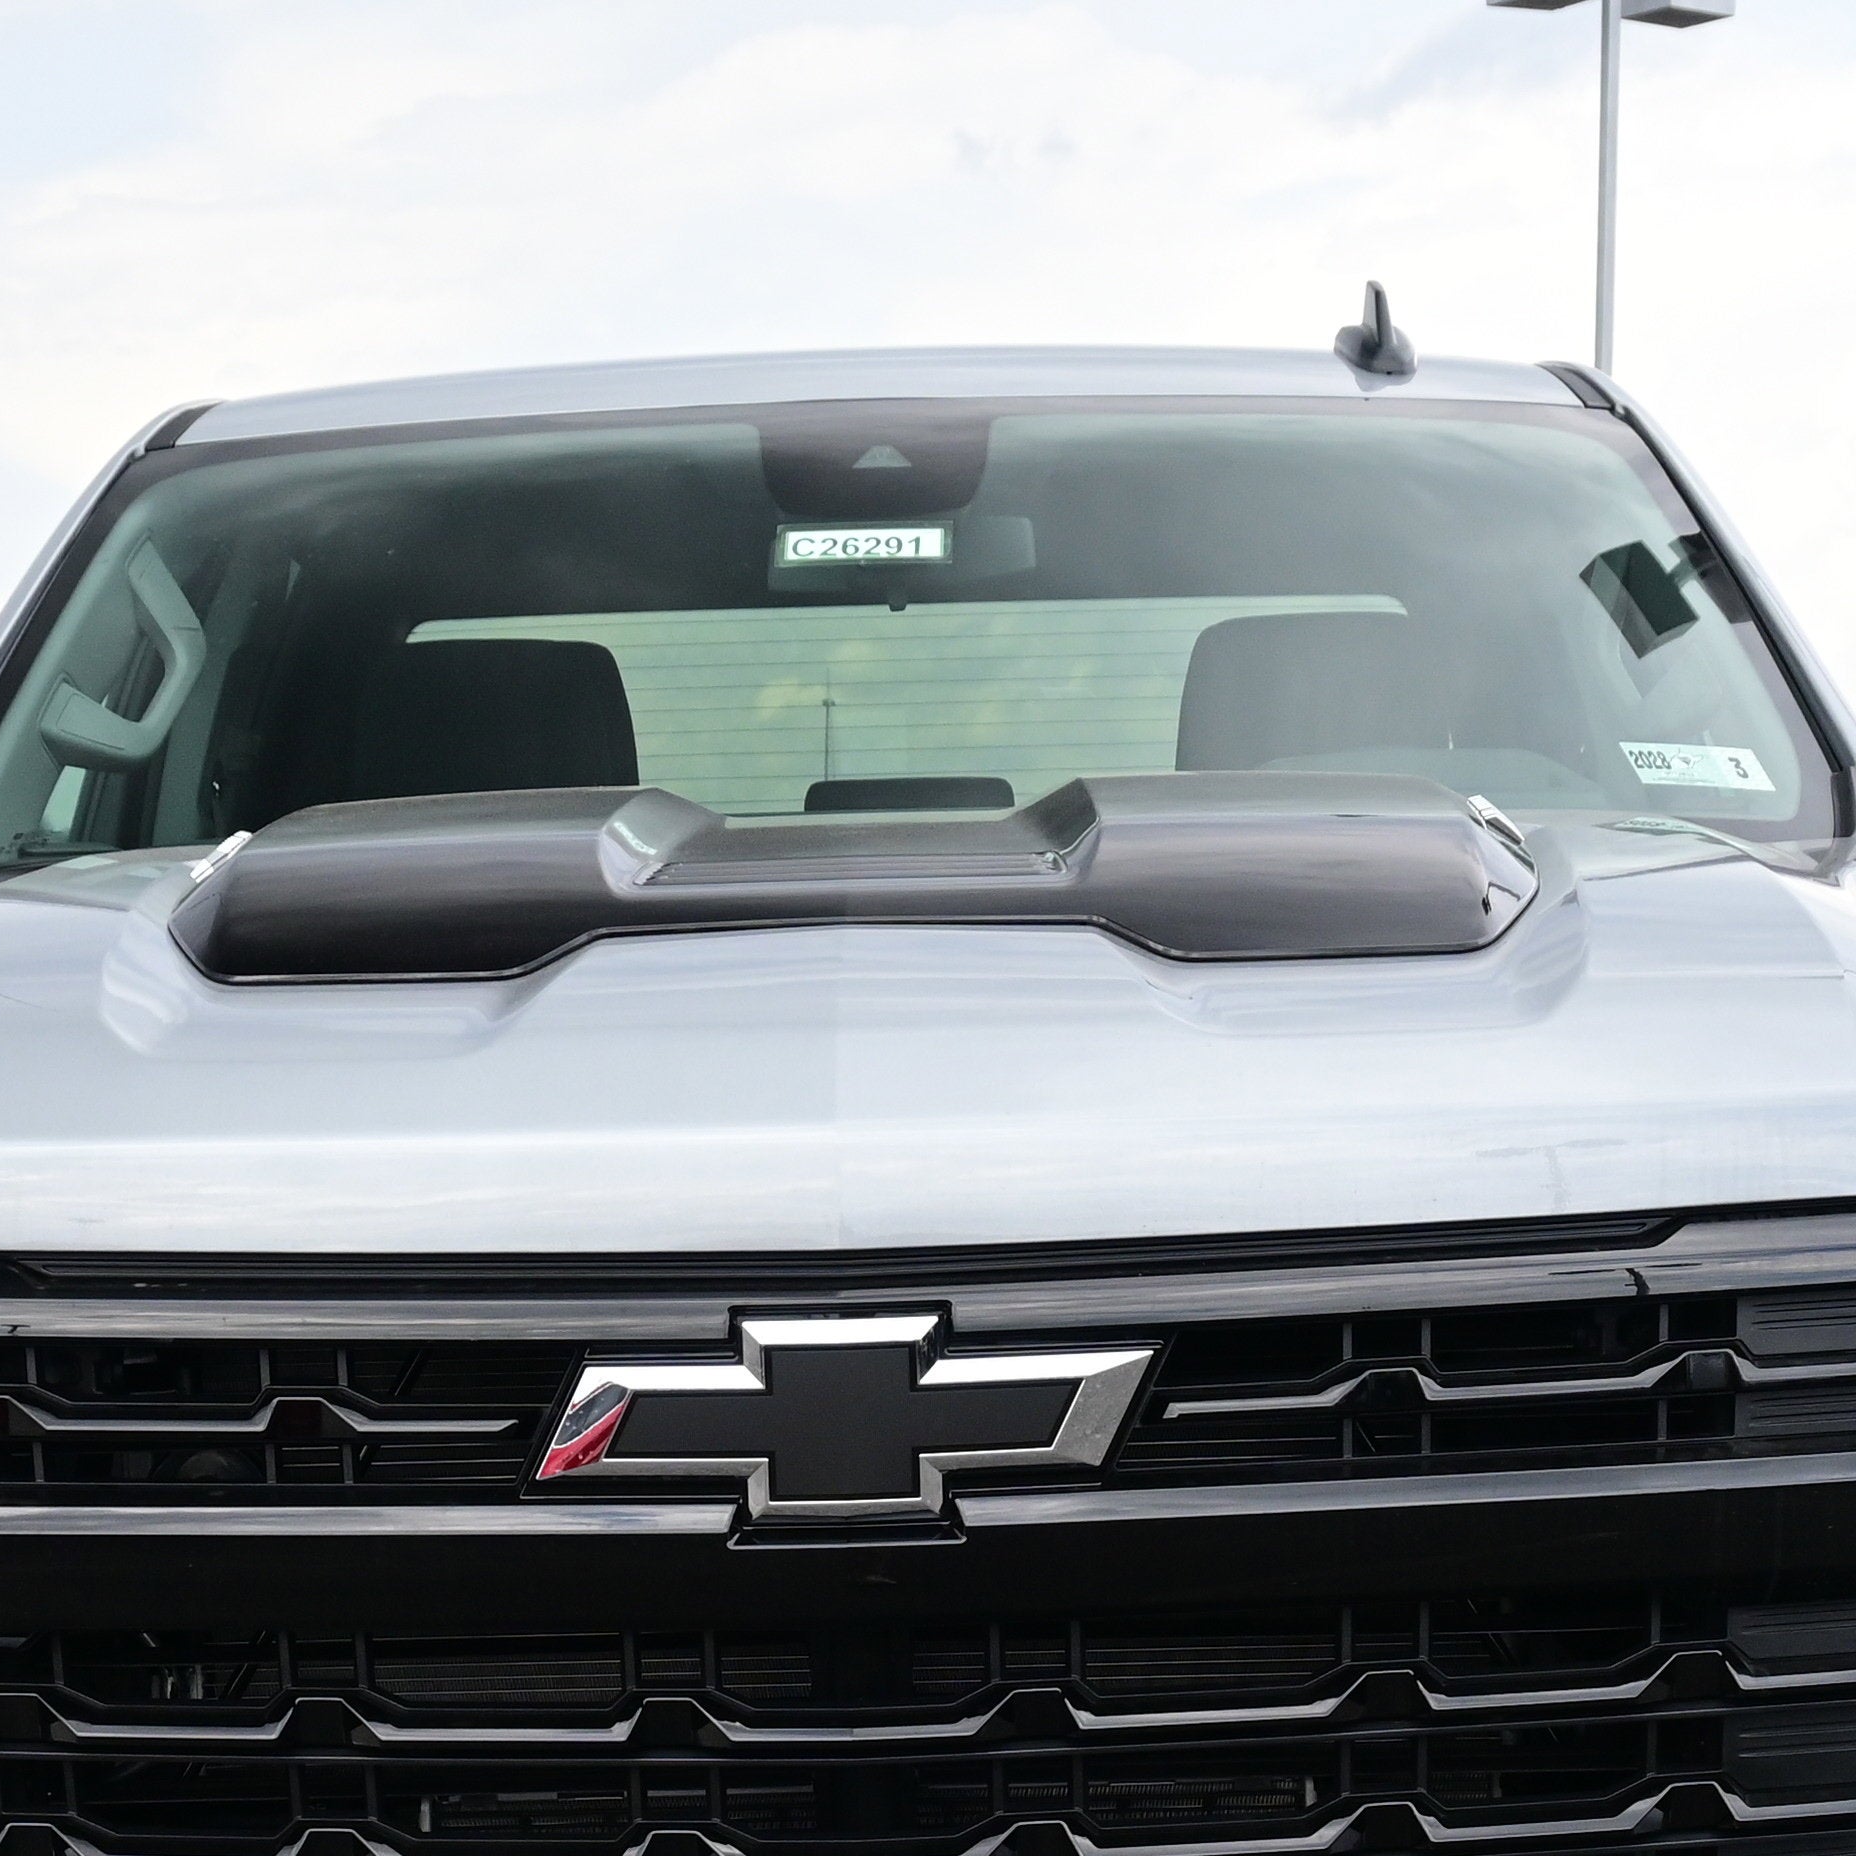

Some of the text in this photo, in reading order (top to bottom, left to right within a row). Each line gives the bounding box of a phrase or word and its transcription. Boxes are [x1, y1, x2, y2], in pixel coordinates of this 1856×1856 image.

[791, 535, 923, 558] C26291
[1628, 750, 1673, 770] 2028
[1727, 756, 1750, 780] 3
